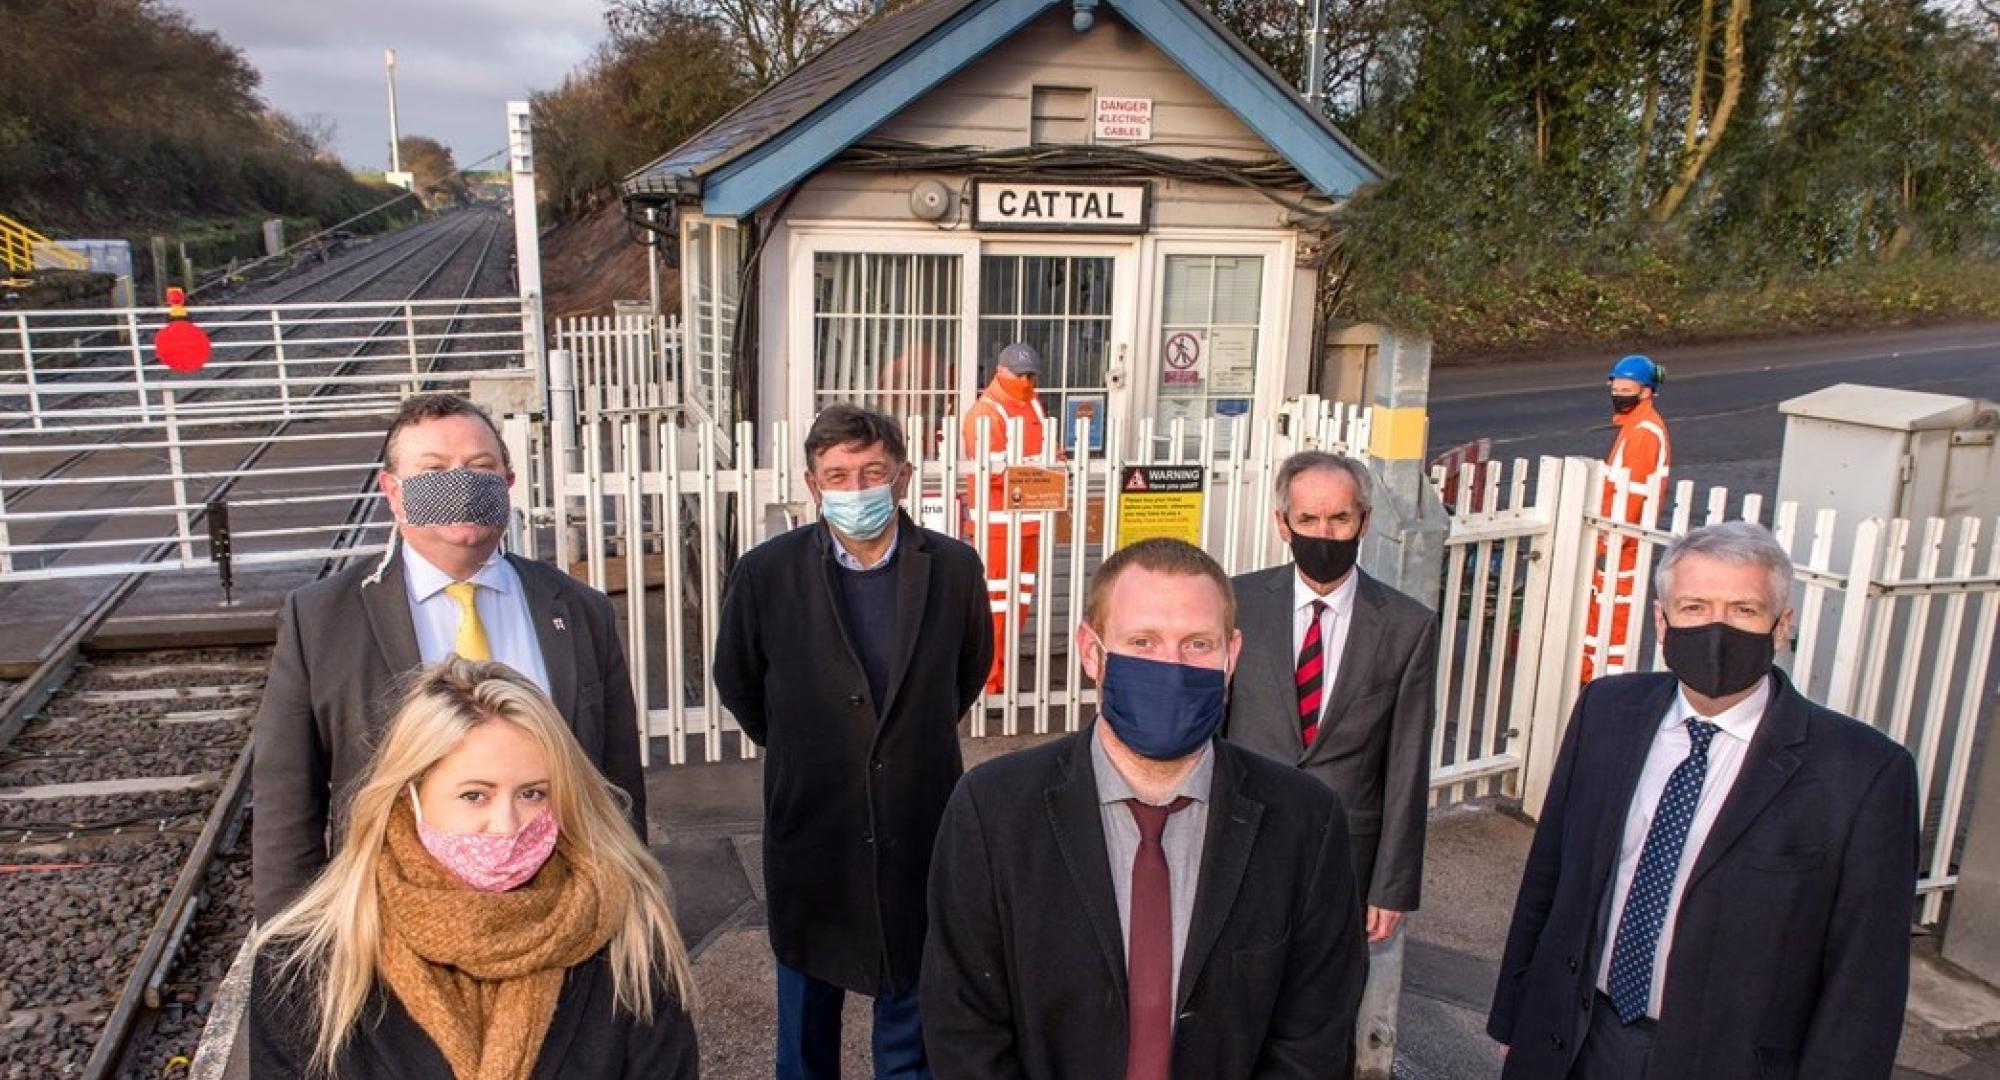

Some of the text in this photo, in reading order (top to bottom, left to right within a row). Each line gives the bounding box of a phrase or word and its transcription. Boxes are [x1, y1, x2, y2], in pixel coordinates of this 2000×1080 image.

[1101, 100, 1148, 112] DANGER
[1101, 114, 1146, 124] ELECTRIC
[1104, 127, 1142, 136] CABLES
[998, 189, 1124, 218] CATTAL
[1149, 469, 1200, 480] WARNING
